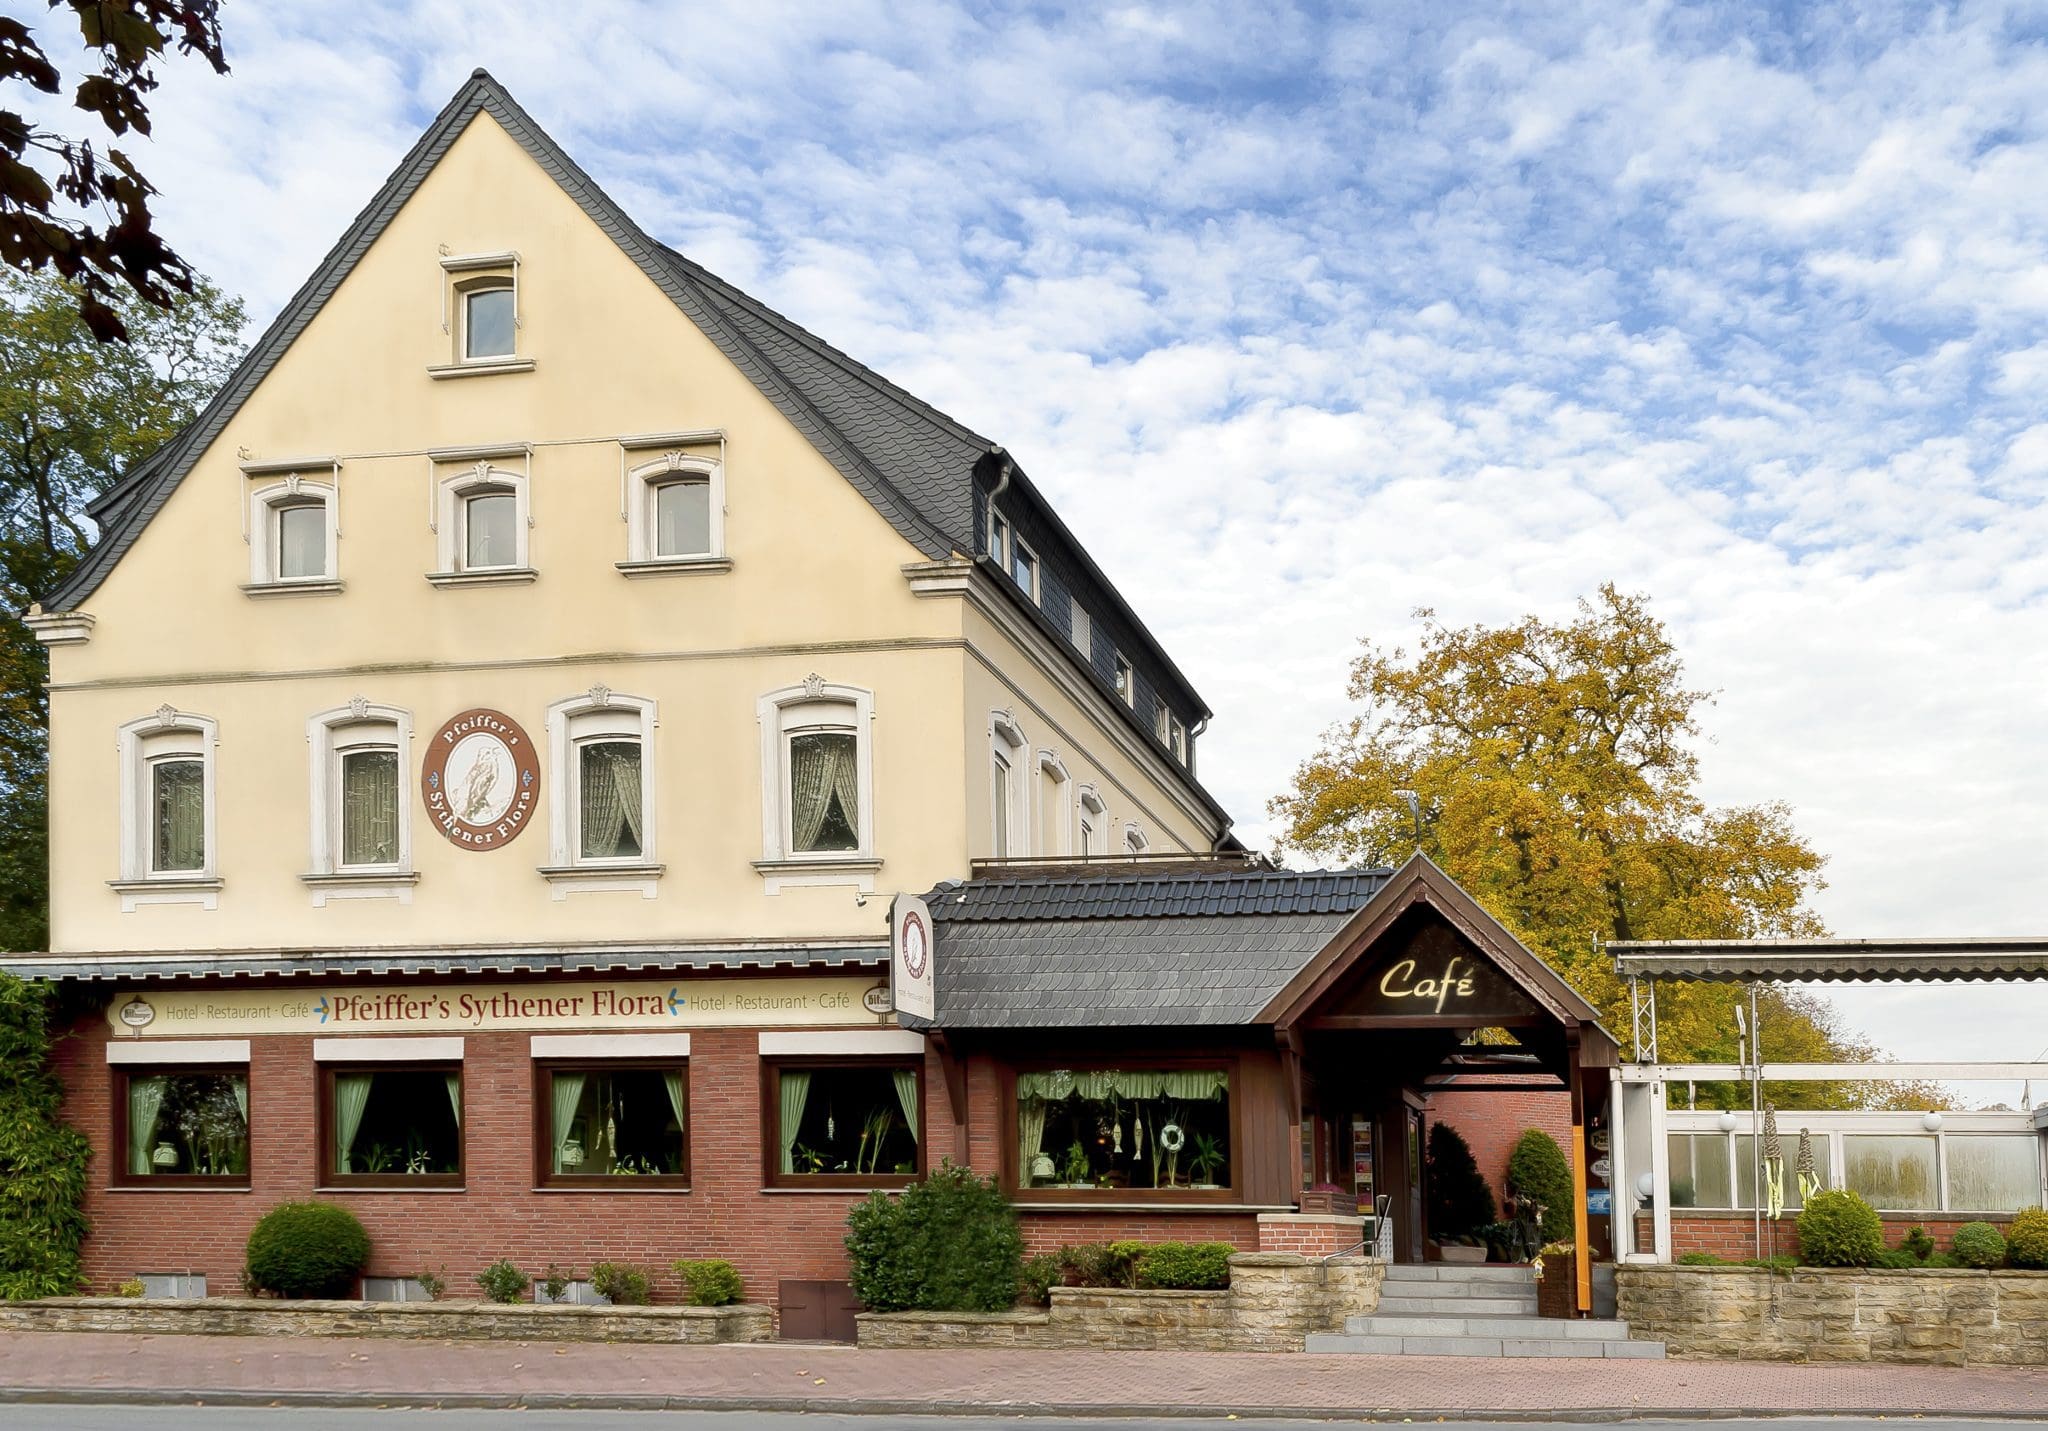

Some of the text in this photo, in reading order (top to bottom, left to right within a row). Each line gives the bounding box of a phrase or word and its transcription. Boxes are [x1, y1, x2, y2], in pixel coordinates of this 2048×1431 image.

[444, 715, 519, 744] Pfeiffer's
[430, 791, 531, 844] Sythener Flora
[690, 995, 726, 1011] Hotel
[736, 994, 808, 1010] Restaurant
[819, 992, 850, 1009] Café
[1380, 957, 1476, 1014] Café
[166, 1004, 199, 1020] Hotel
[207, 1003, 271, 1019] Restaurant
[281, 1002, 309, 1018] Café
[332, 990, 664, 1026] Pfeiffer's Sythener Flora
